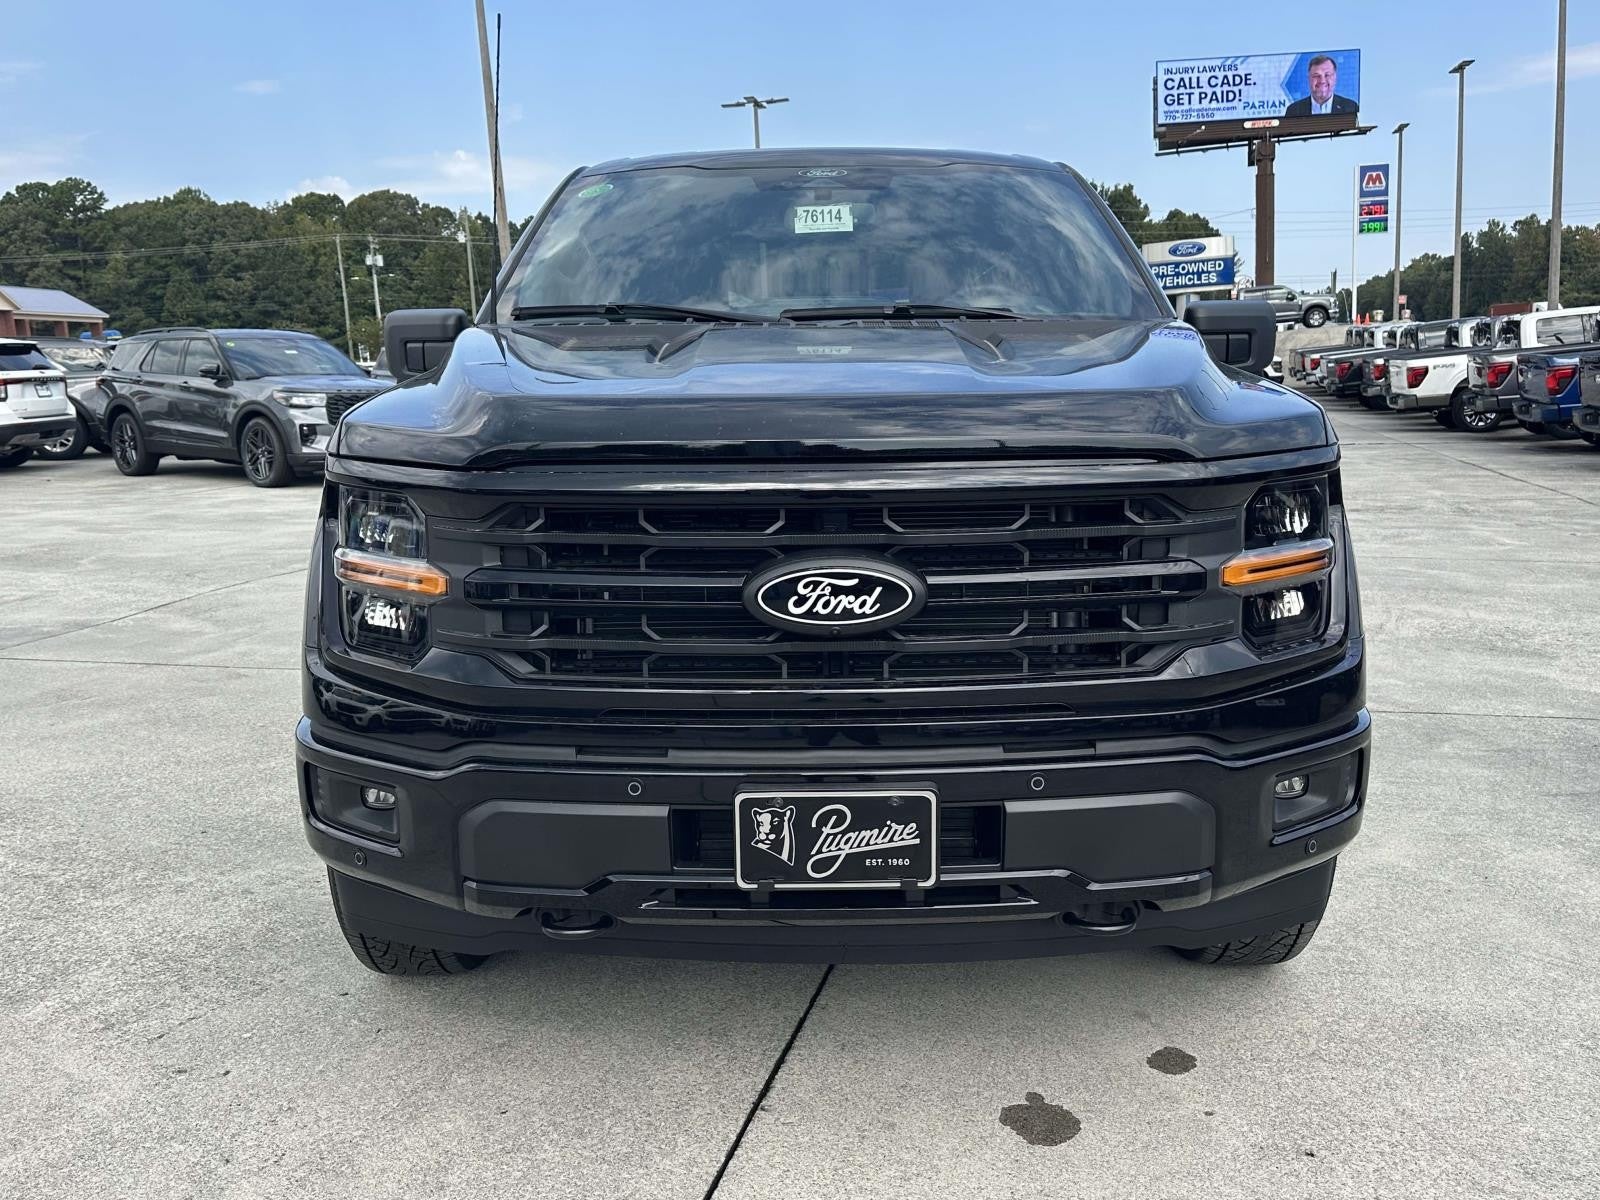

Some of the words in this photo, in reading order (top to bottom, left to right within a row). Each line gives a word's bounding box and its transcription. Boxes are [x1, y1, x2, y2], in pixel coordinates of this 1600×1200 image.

[1164, 66, 1195, 75] INJURY
[1197, 64, 1239, 74] LAWYERS
[1163, 76, 1204, 91] CALL
[1207, 73, 1257, 88] CADE.
[1163, 92, 1195, 106] GET
[1198, 89, 1242, 105] PAID!
[1243, 99, 1286, 110] PARIAN
[807, 168, 839, 176] Ford
[803, 208, 842, 223] 76114
[1176, 244, 1199, 255] Ford
[1152, 260, 1224, 276] PRE-OWNED
[1158, 273, 1217, 287] VEHICLES
[788, 577, 883, 615] Ford
[806, 804, 921, 879] Pugmire
[865, 858, 885, 866] EST.
[887, 858, 910, 866] 1960
